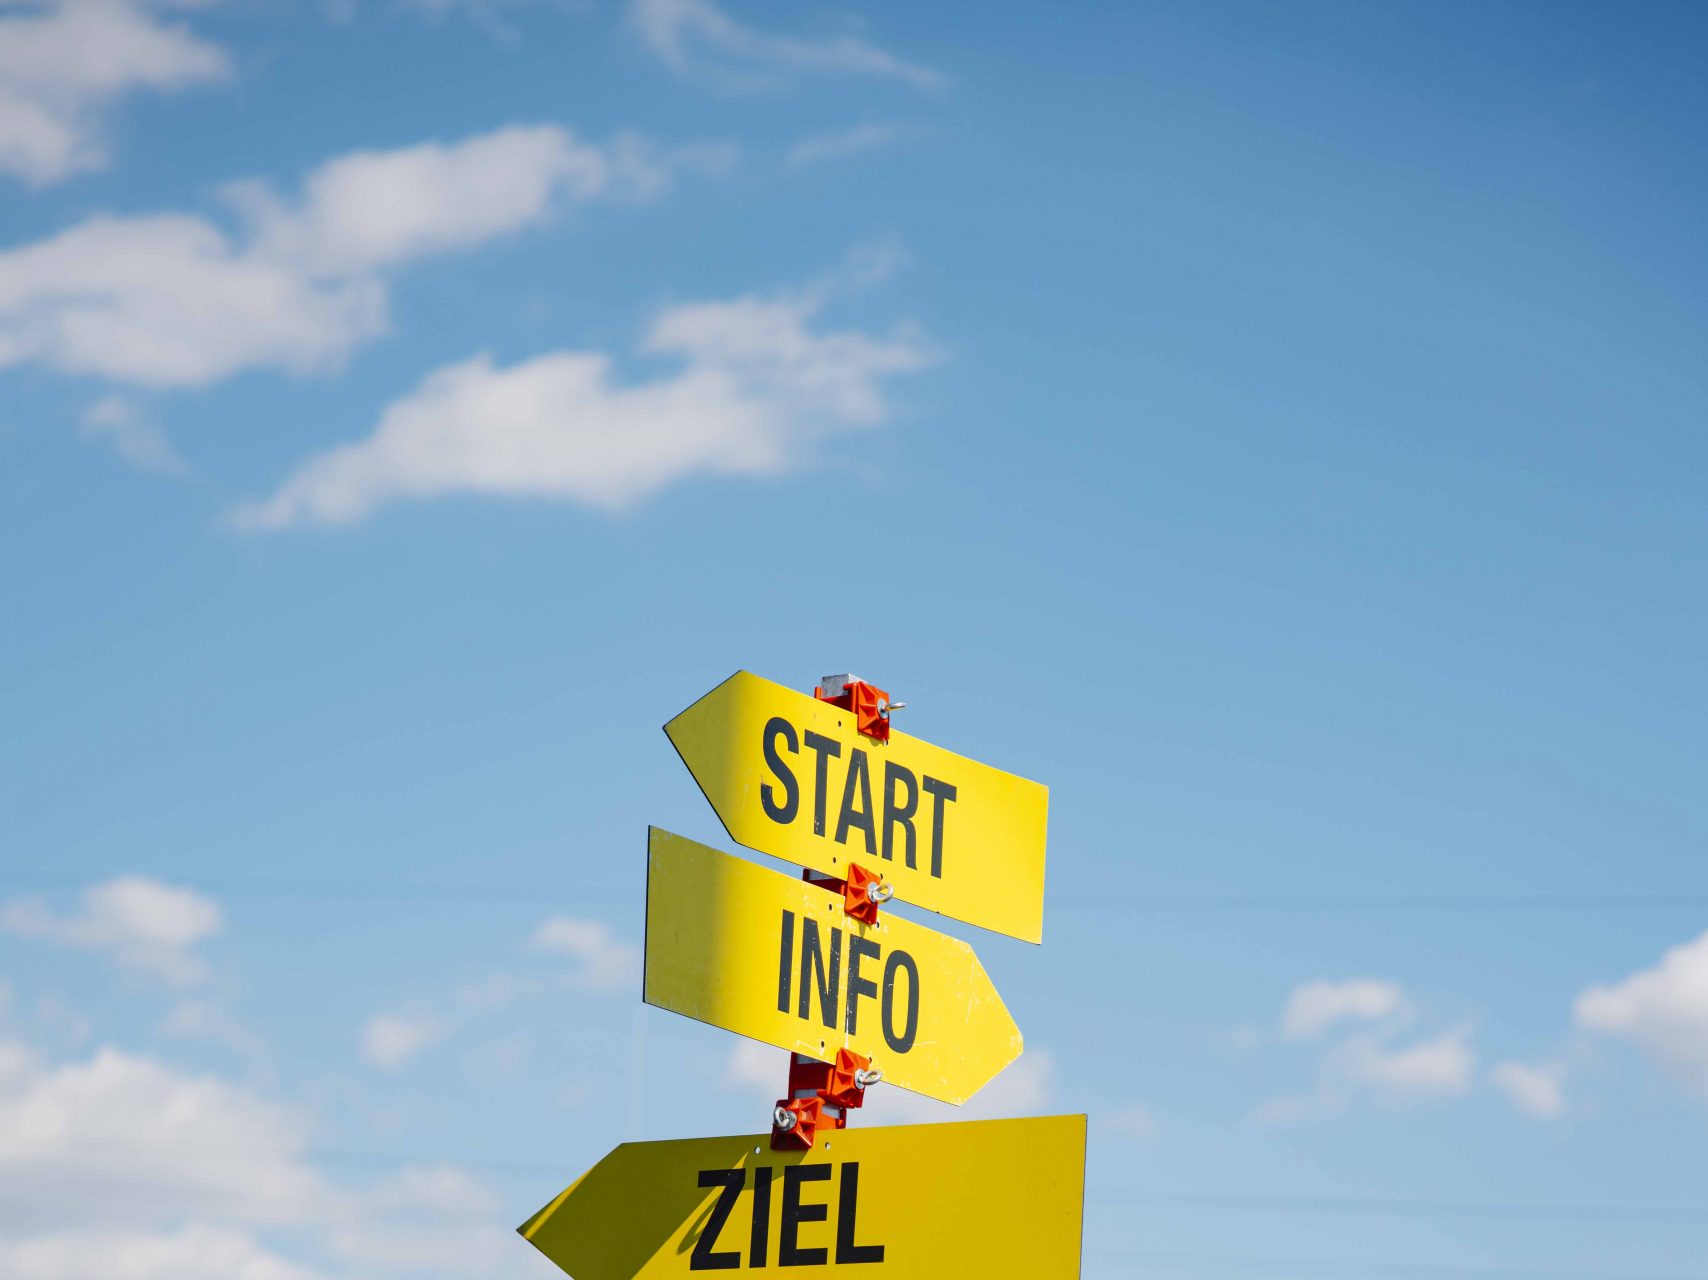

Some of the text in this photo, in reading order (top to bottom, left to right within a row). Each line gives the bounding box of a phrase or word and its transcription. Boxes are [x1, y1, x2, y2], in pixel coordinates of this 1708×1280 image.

[761, 717, 957, 878] START
[777, 910, 920, 1054] INFO
[690, 1162, 884, 1270] ZIEL
